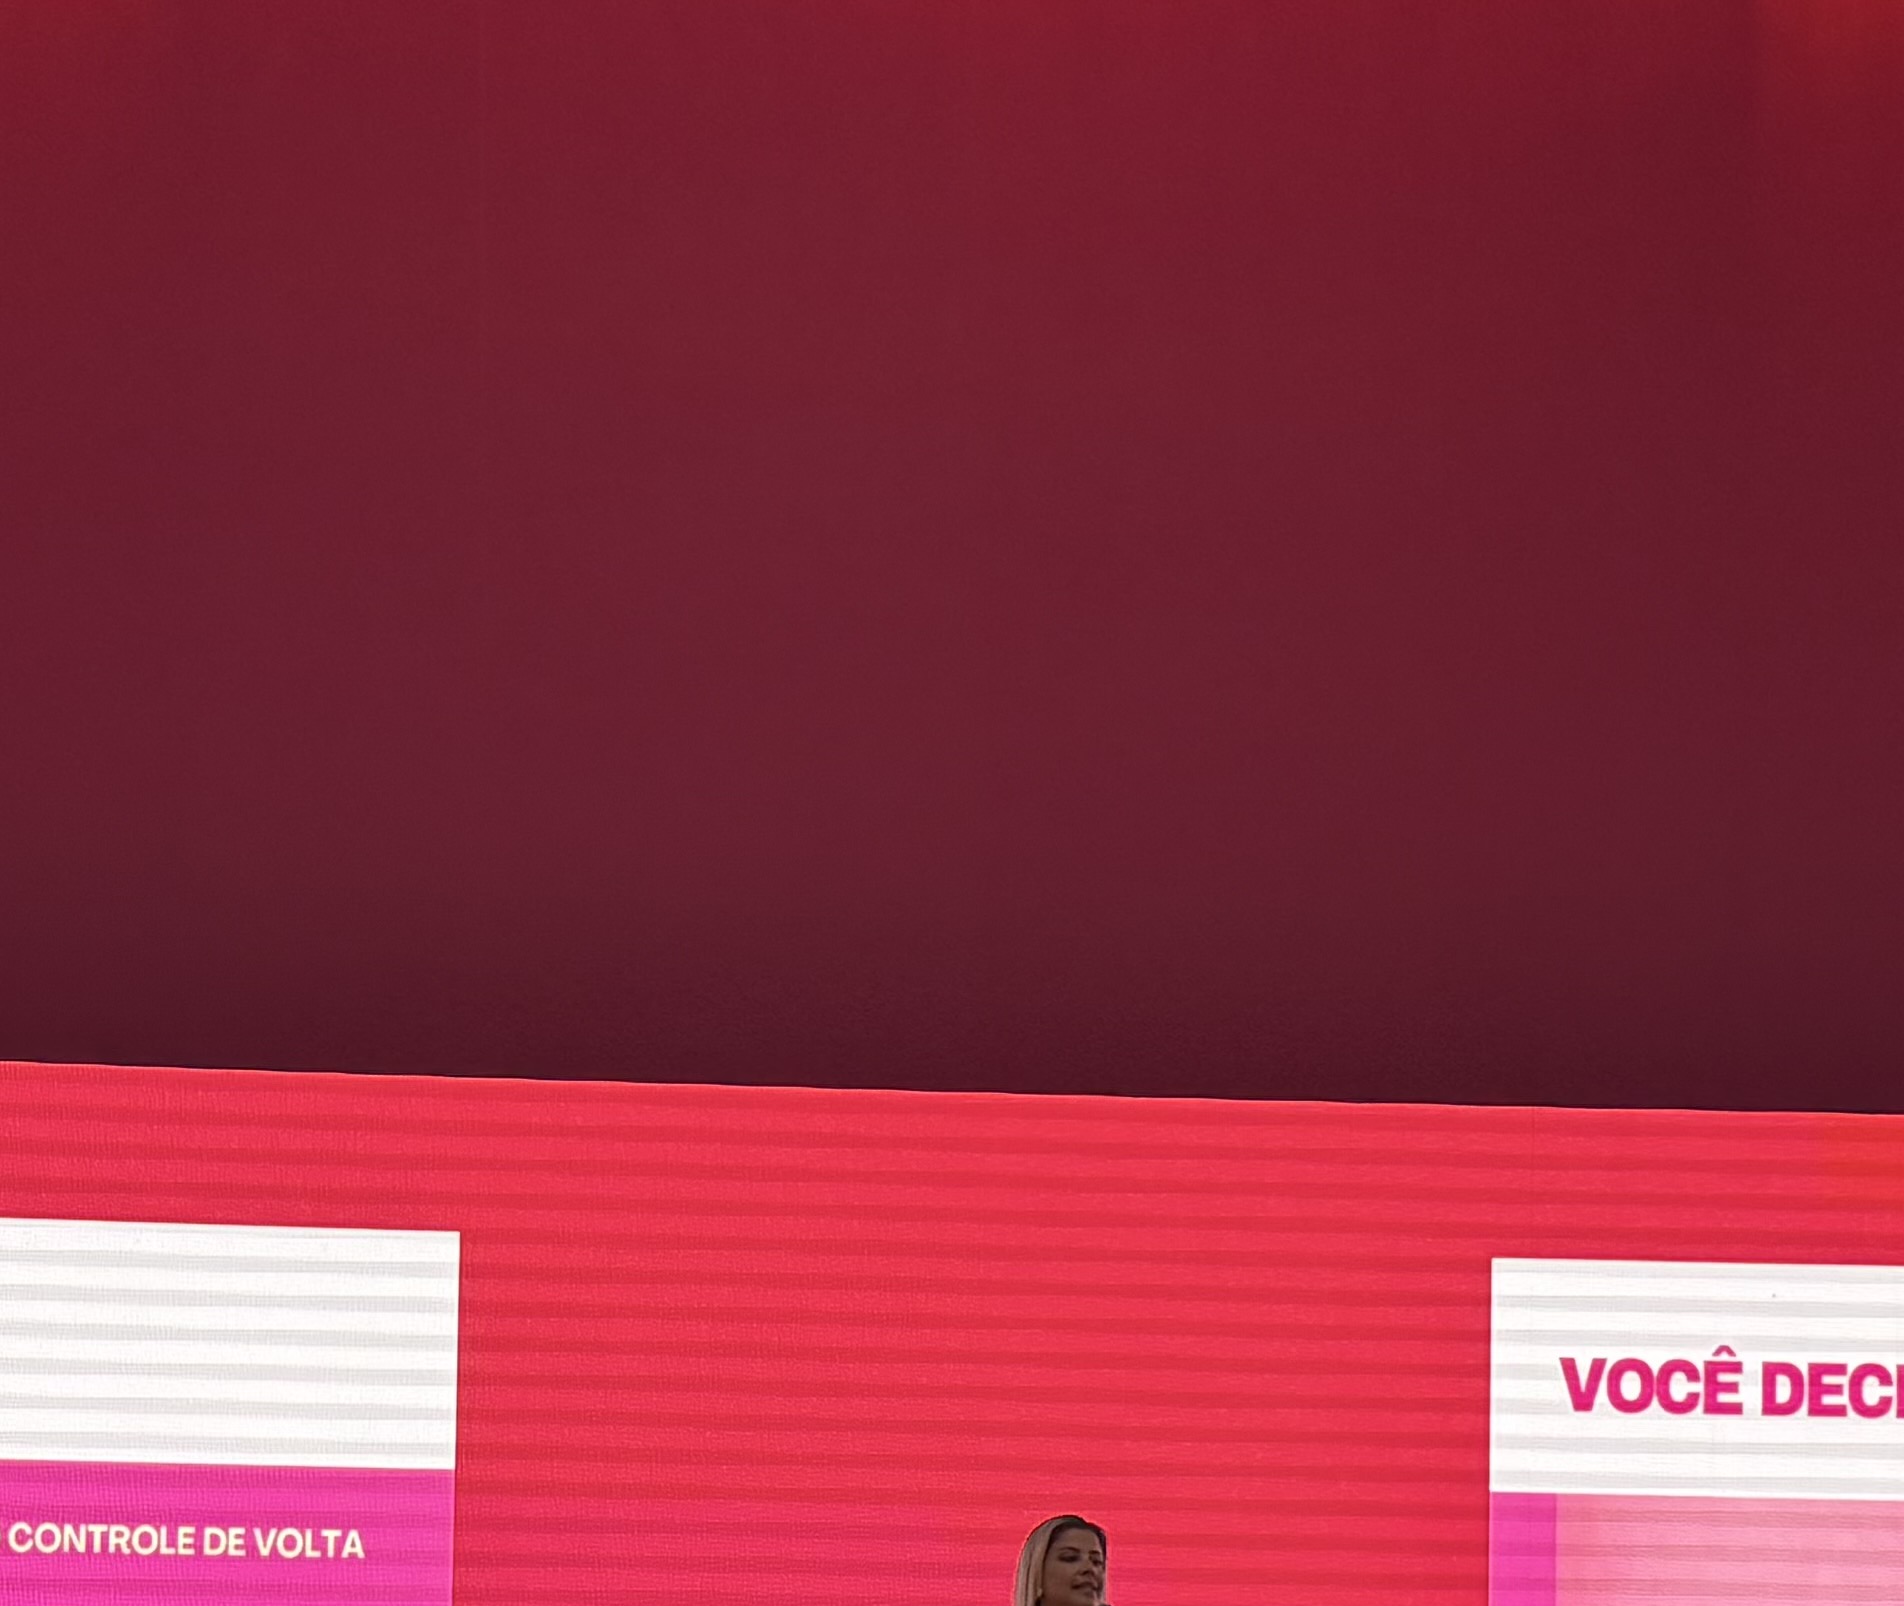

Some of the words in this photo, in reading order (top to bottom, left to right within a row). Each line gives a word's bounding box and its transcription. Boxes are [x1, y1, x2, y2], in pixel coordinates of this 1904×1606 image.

[1559, 1345, 1743, 1414] VOCÊ
[8, 1522, 195, 1555] CONTROLE
[203, 1527, 246, 1556] DE
[253, 1527, 365, 1559] VOLTA
